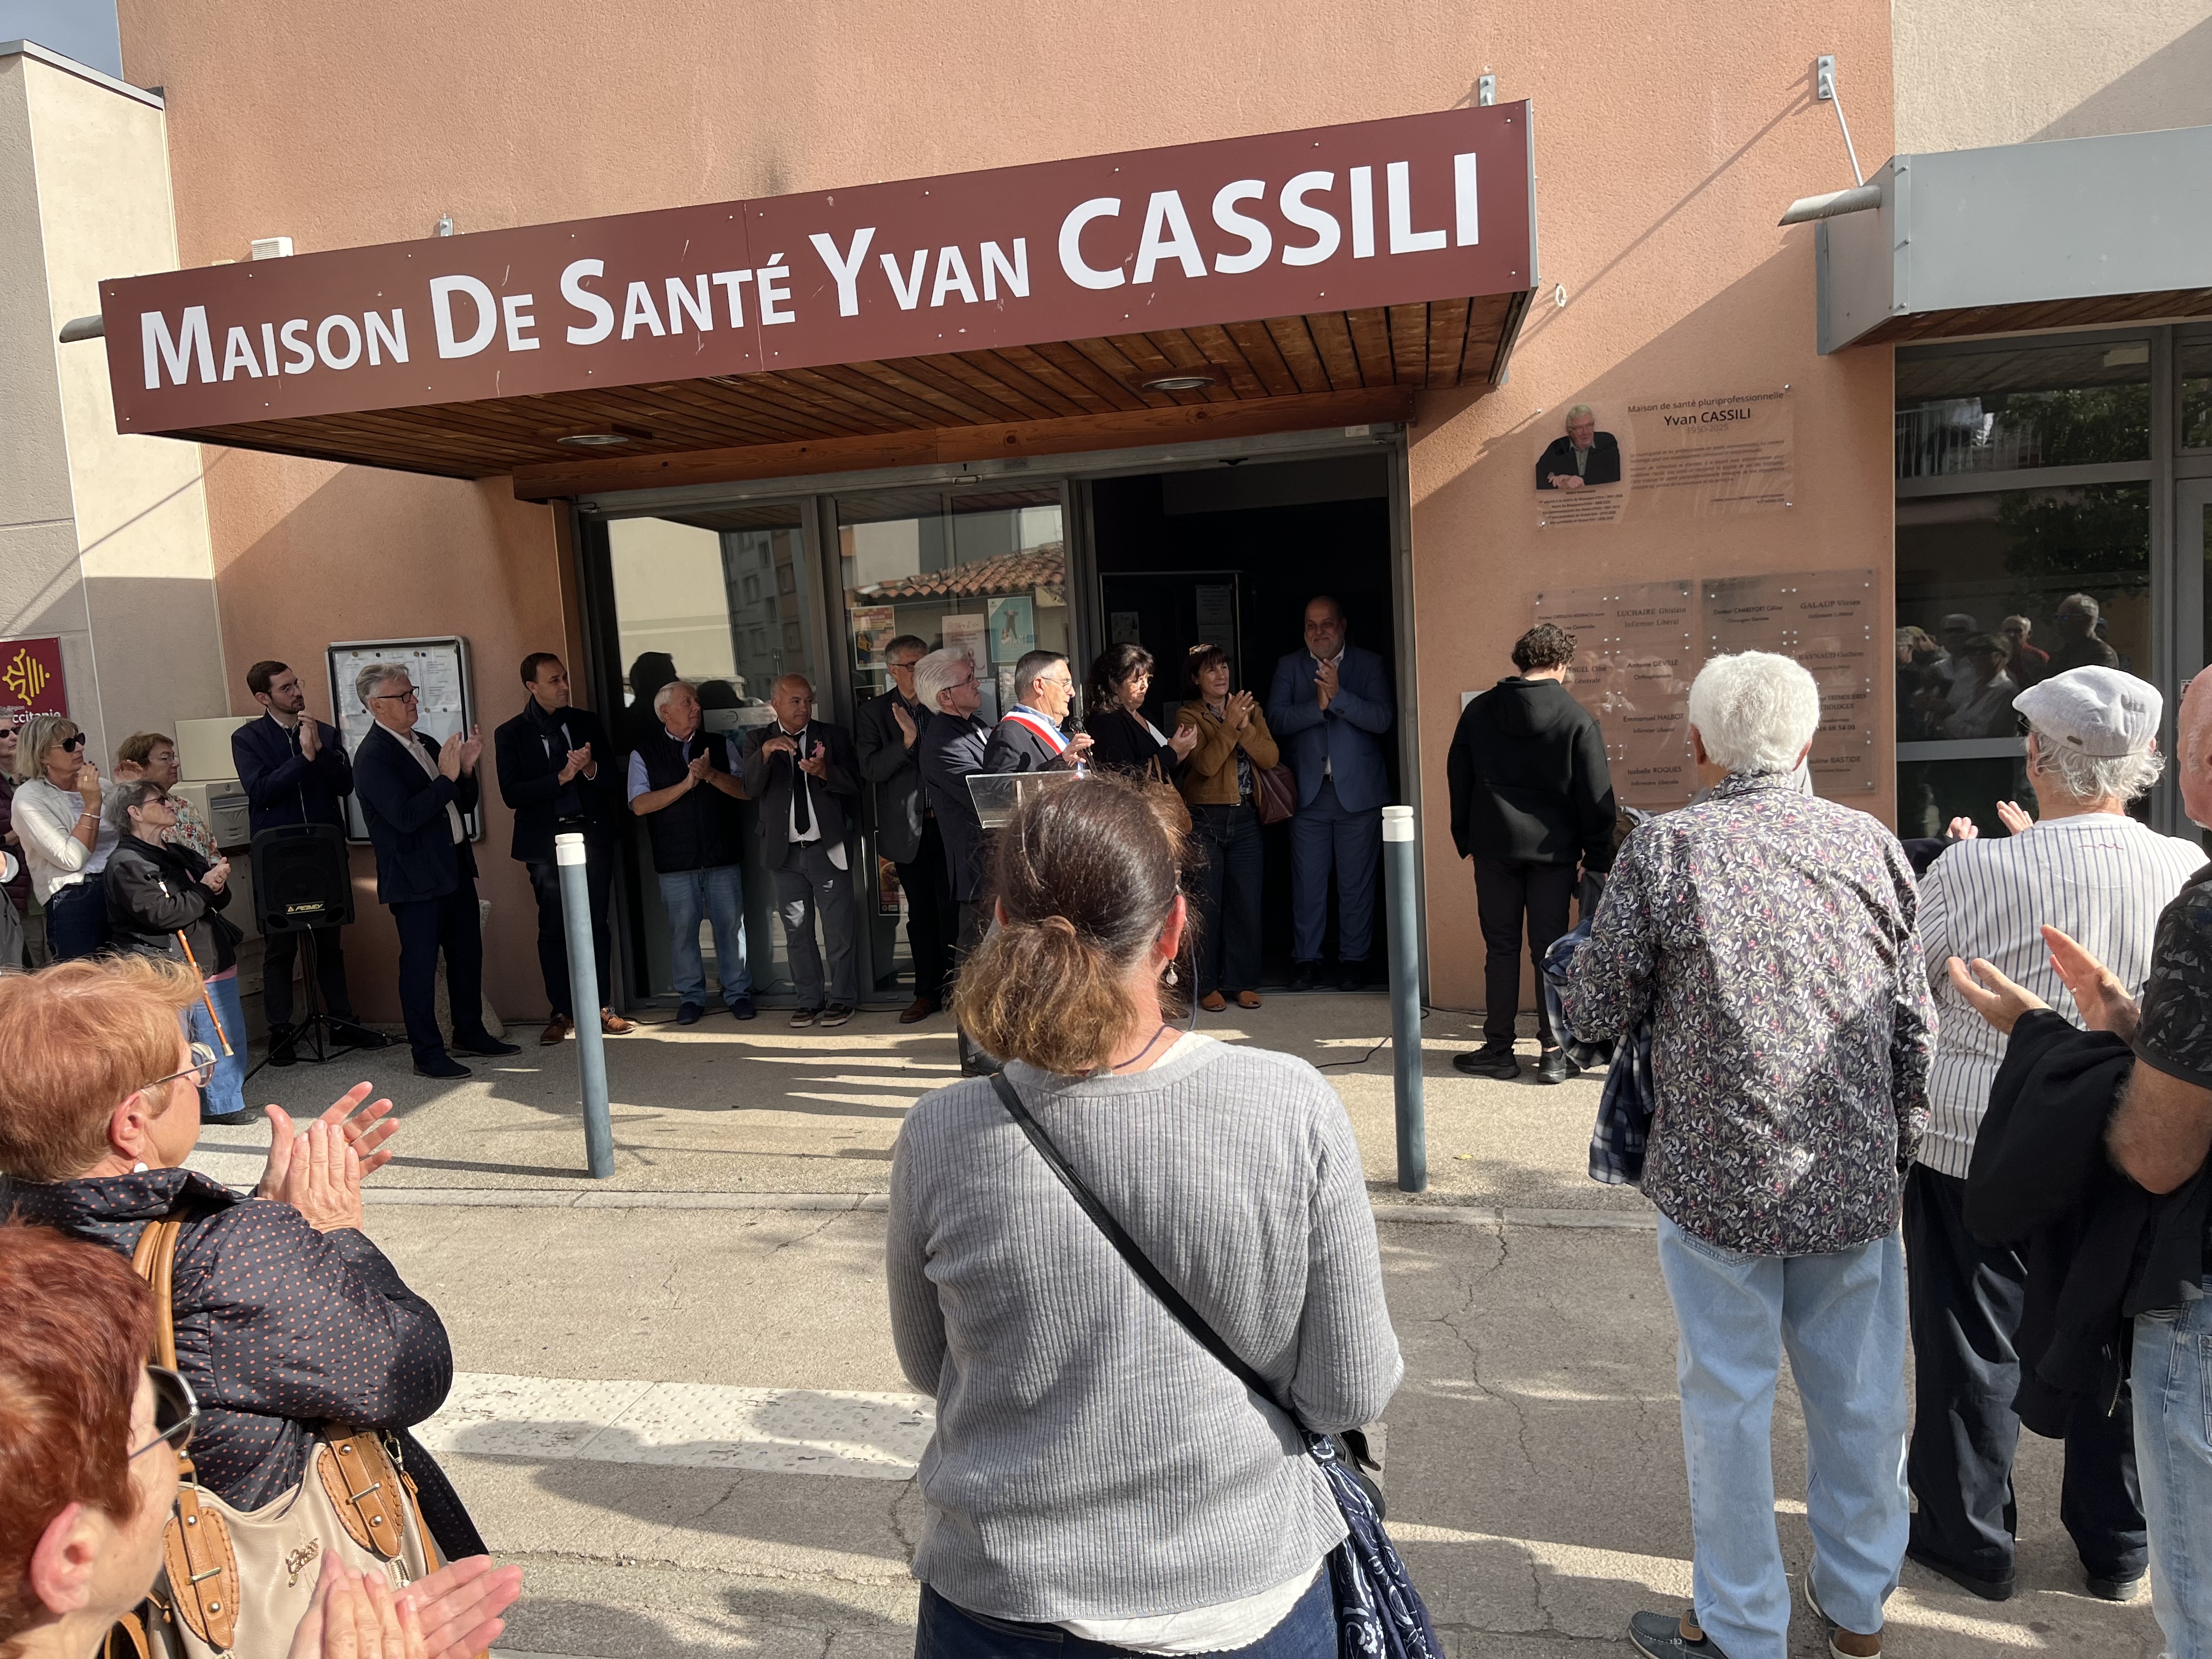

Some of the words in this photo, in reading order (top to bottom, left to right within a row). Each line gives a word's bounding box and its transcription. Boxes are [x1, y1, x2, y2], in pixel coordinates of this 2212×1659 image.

[1058, 152, 1479, 290] CASSILI
[1628, 403, 1658, 413] Maison
[1660, 402, 1671, 410] de
[1672, 399, 1696, 409] santé
[1698, 391, 1784, 408] pluriprofessionnelle
[1664, 415, 1697, 426] Yvan
[1701, 408, 1751, 423] CASSILI
[1687, 424, 1729, 434] 1950-2025
[1617, 608, 1656, 617] LUCHAIRE
[1658, 606, 1686, 615] Ghislain
[1656, 618, 1679, 626] Libéral
[1653, 659, 1679, 667] DEVILLE
[1566, 665, 1589, 673] ENGEL
[1830, 755, 1861, 764] BASTIDE
[1652, 765, 1682, 774] ROQUES
